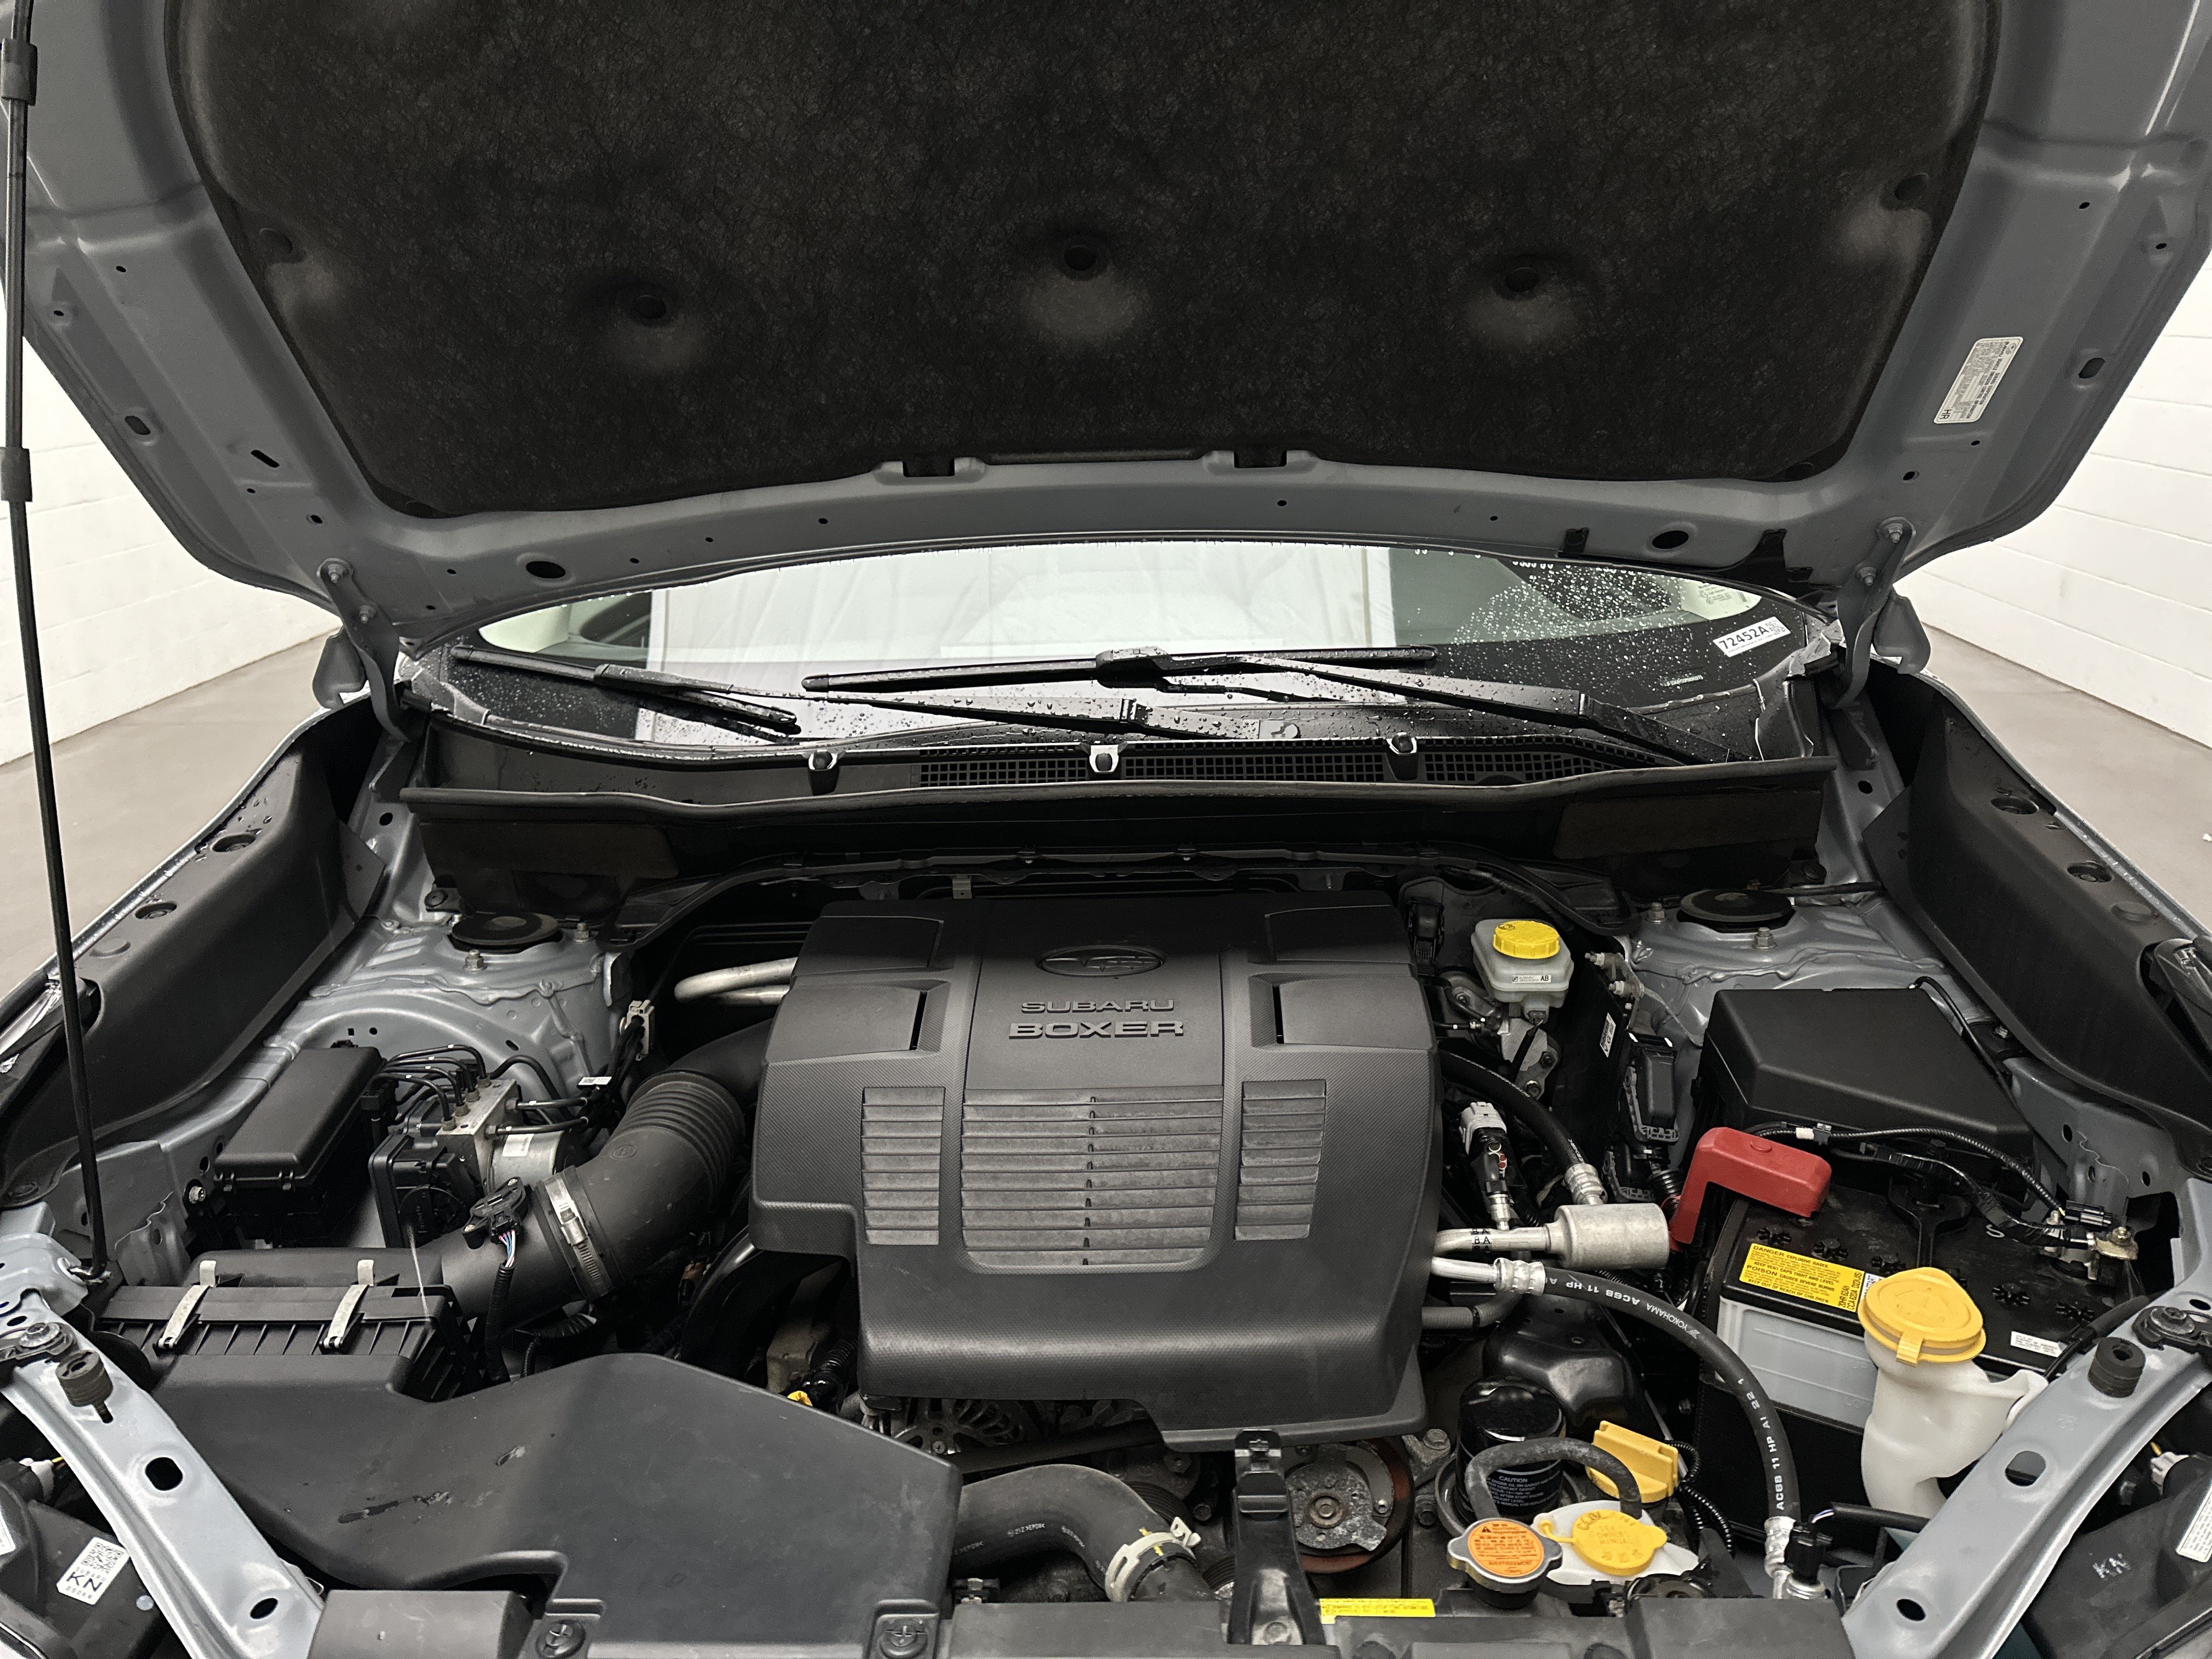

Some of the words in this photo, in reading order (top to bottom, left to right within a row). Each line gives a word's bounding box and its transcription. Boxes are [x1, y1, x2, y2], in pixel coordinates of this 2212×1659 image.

[1939, 409, 1953, 419] HR
[1718, 626, 1769, 649] 72452A
[1022, 999, 1174, 1013] SUBARU
[1009, 1020, 1184, 1039] BOXER
[1753, 1245, 1784, 1256] DANGER
[1786, 1255, 1810, 1263] EXPLOSIVE
[1746, 1265, 1778, 1276] POISON
[1779, 1273, 1798, 1282] CAUSES
[1588, 1285, 1599, 1293] 11
[1804, 1294, 1829, 1303] CHILDREN
[1846, 1299, 1856, 1310] CCA
[1647, 1303, 1688, 1331] YOKOHAMA
[1746, 1391, 1760, 1409] 22
[1767, 1436, 1777, 1453] HP
[1771, 1458, 1780, 1469] 11
[66, 1571, 103, 1592] KN
